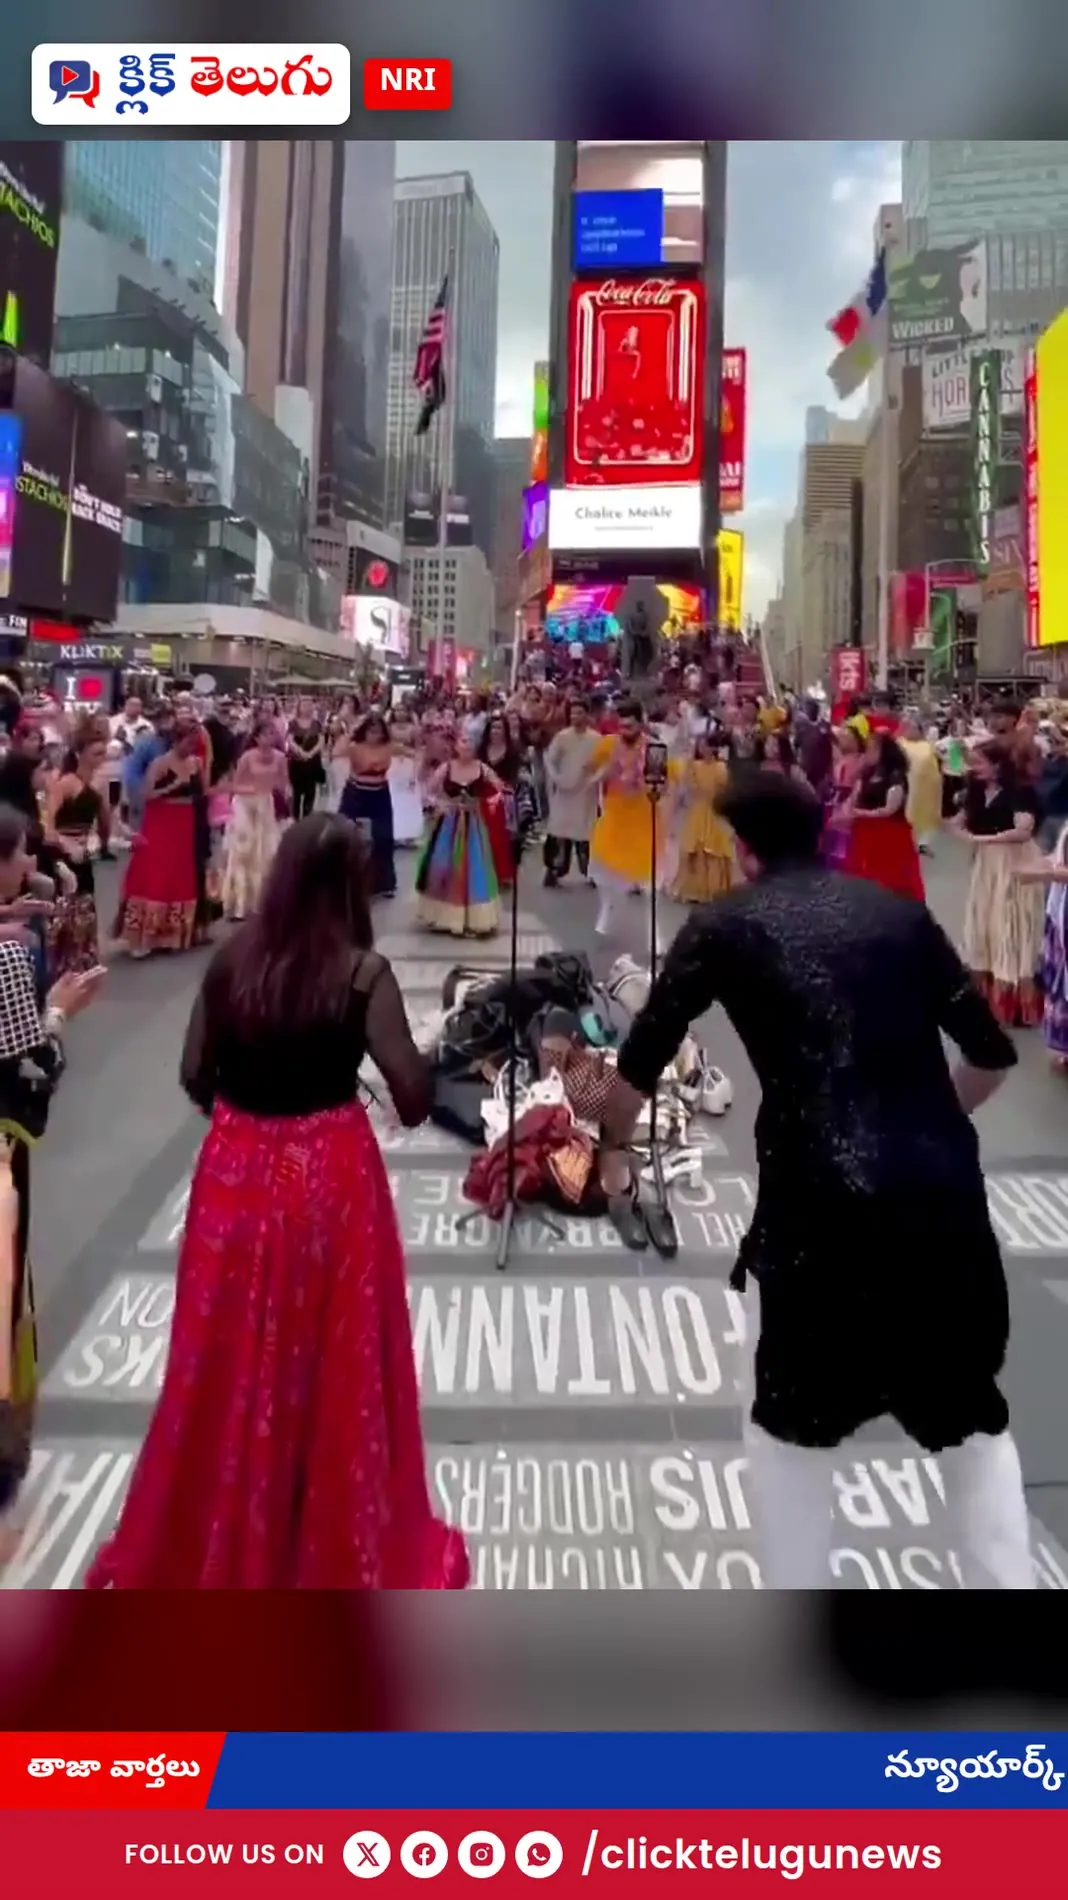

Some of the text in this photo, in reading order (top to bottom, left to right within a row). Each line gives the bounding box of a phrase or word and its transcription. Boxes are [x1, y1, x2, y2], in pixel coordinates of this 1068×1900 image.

[976, 361, 991, 564] CANNABIS
[575, 506, 673, 520] Chalice Meikle
[434, 1456, 635, 1537] RODGERS
